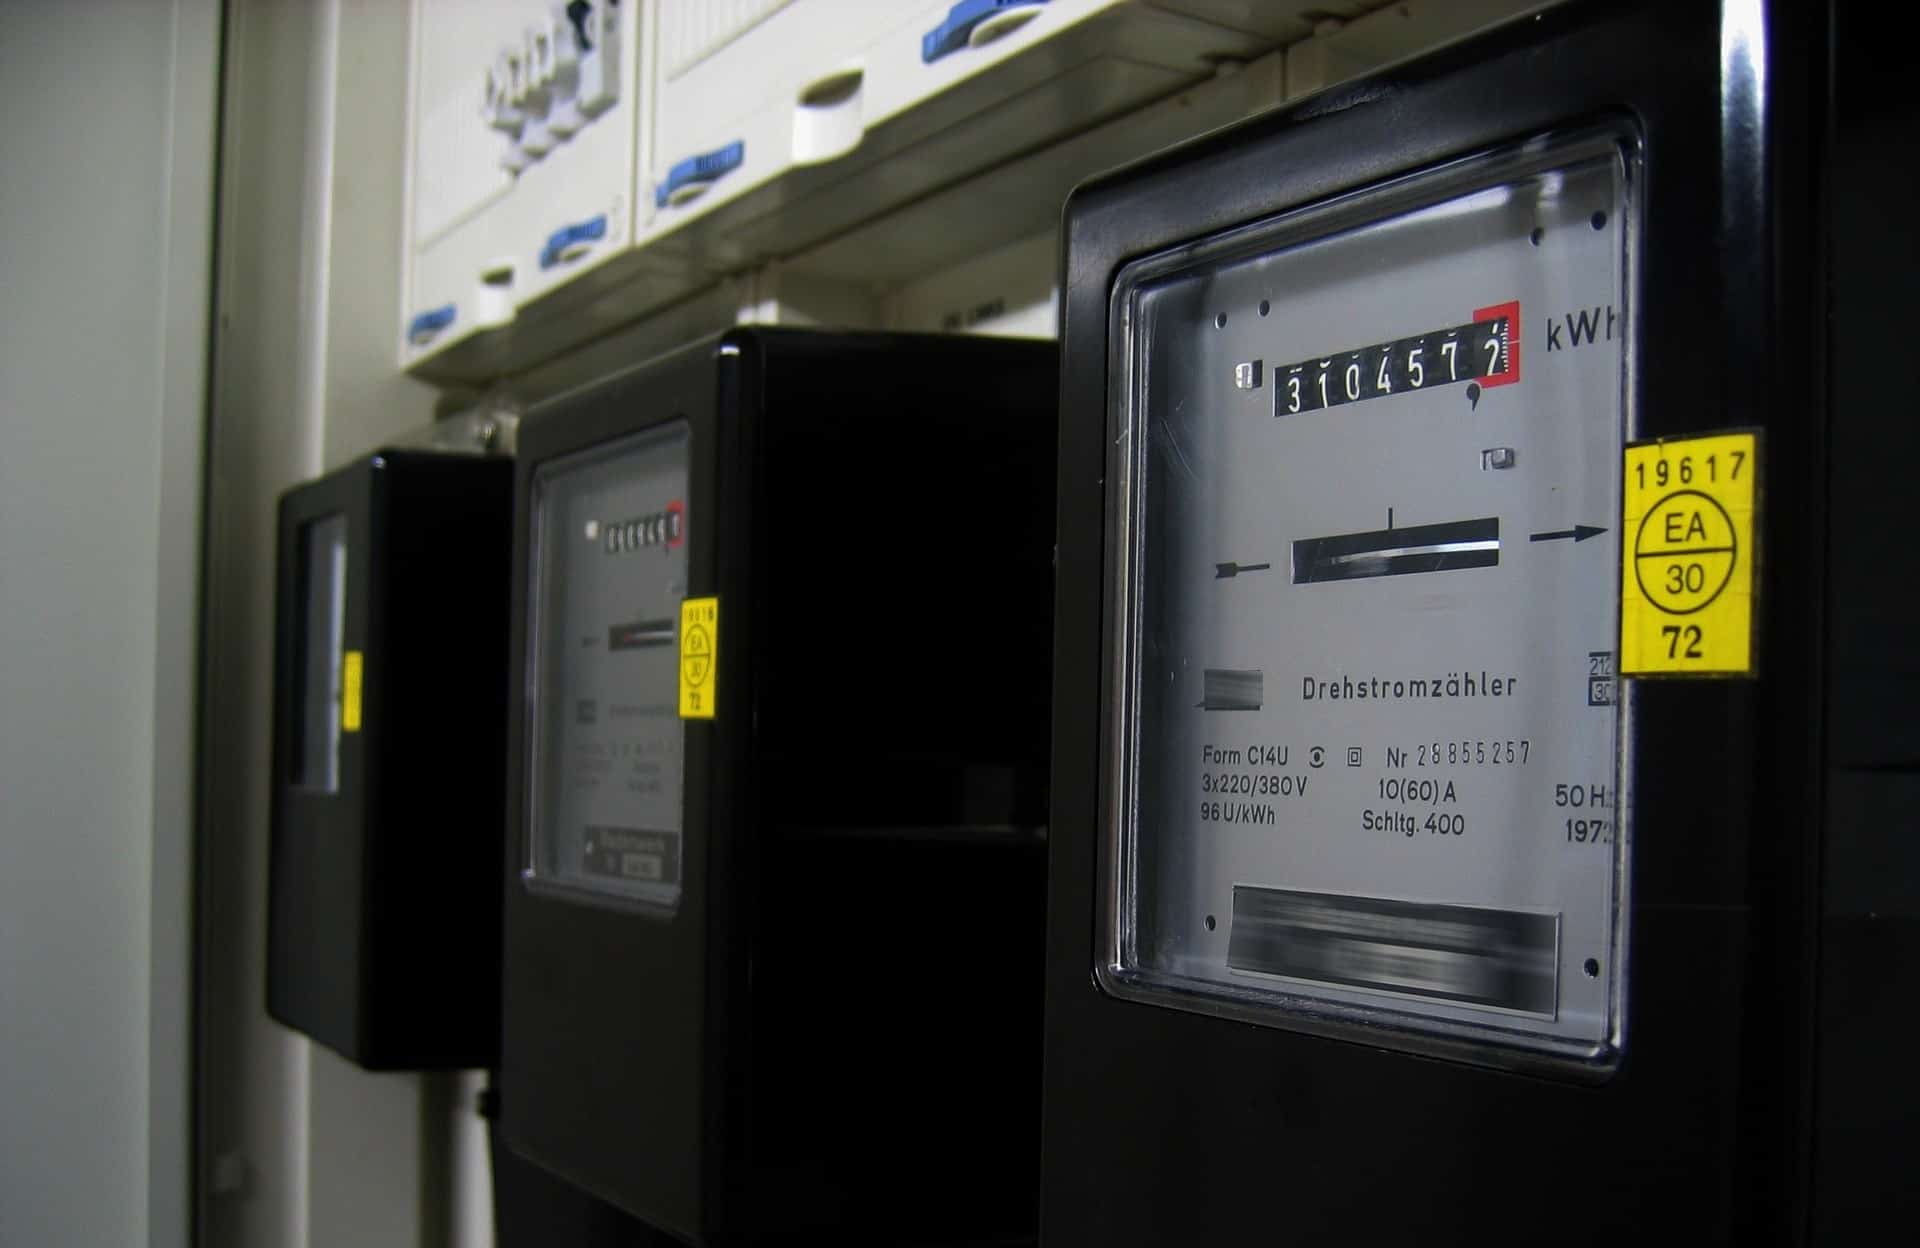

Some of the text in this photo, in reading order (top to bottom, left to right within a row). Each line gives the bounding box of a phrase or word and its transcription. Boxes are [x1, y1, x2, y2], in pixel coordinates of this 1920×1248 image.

[1635, 451, 1746, 489] 19617
[1665, 511, 1707, 543] EA
[1665, 563, 1705, 594] 30
[1662, 624, 1703, 659] 72
[1302, 671, 1518, 700] Drehstromzähler
[1203, 745, 1289, 766] Form C14U
[1386, 740, 1530, 768] Nr 28855257
[1379, 777, 1439, 806] 10(60)
[1555, 784, 1585, 807] 50
[1362, 809, 1465, 838] Schltg. 400
